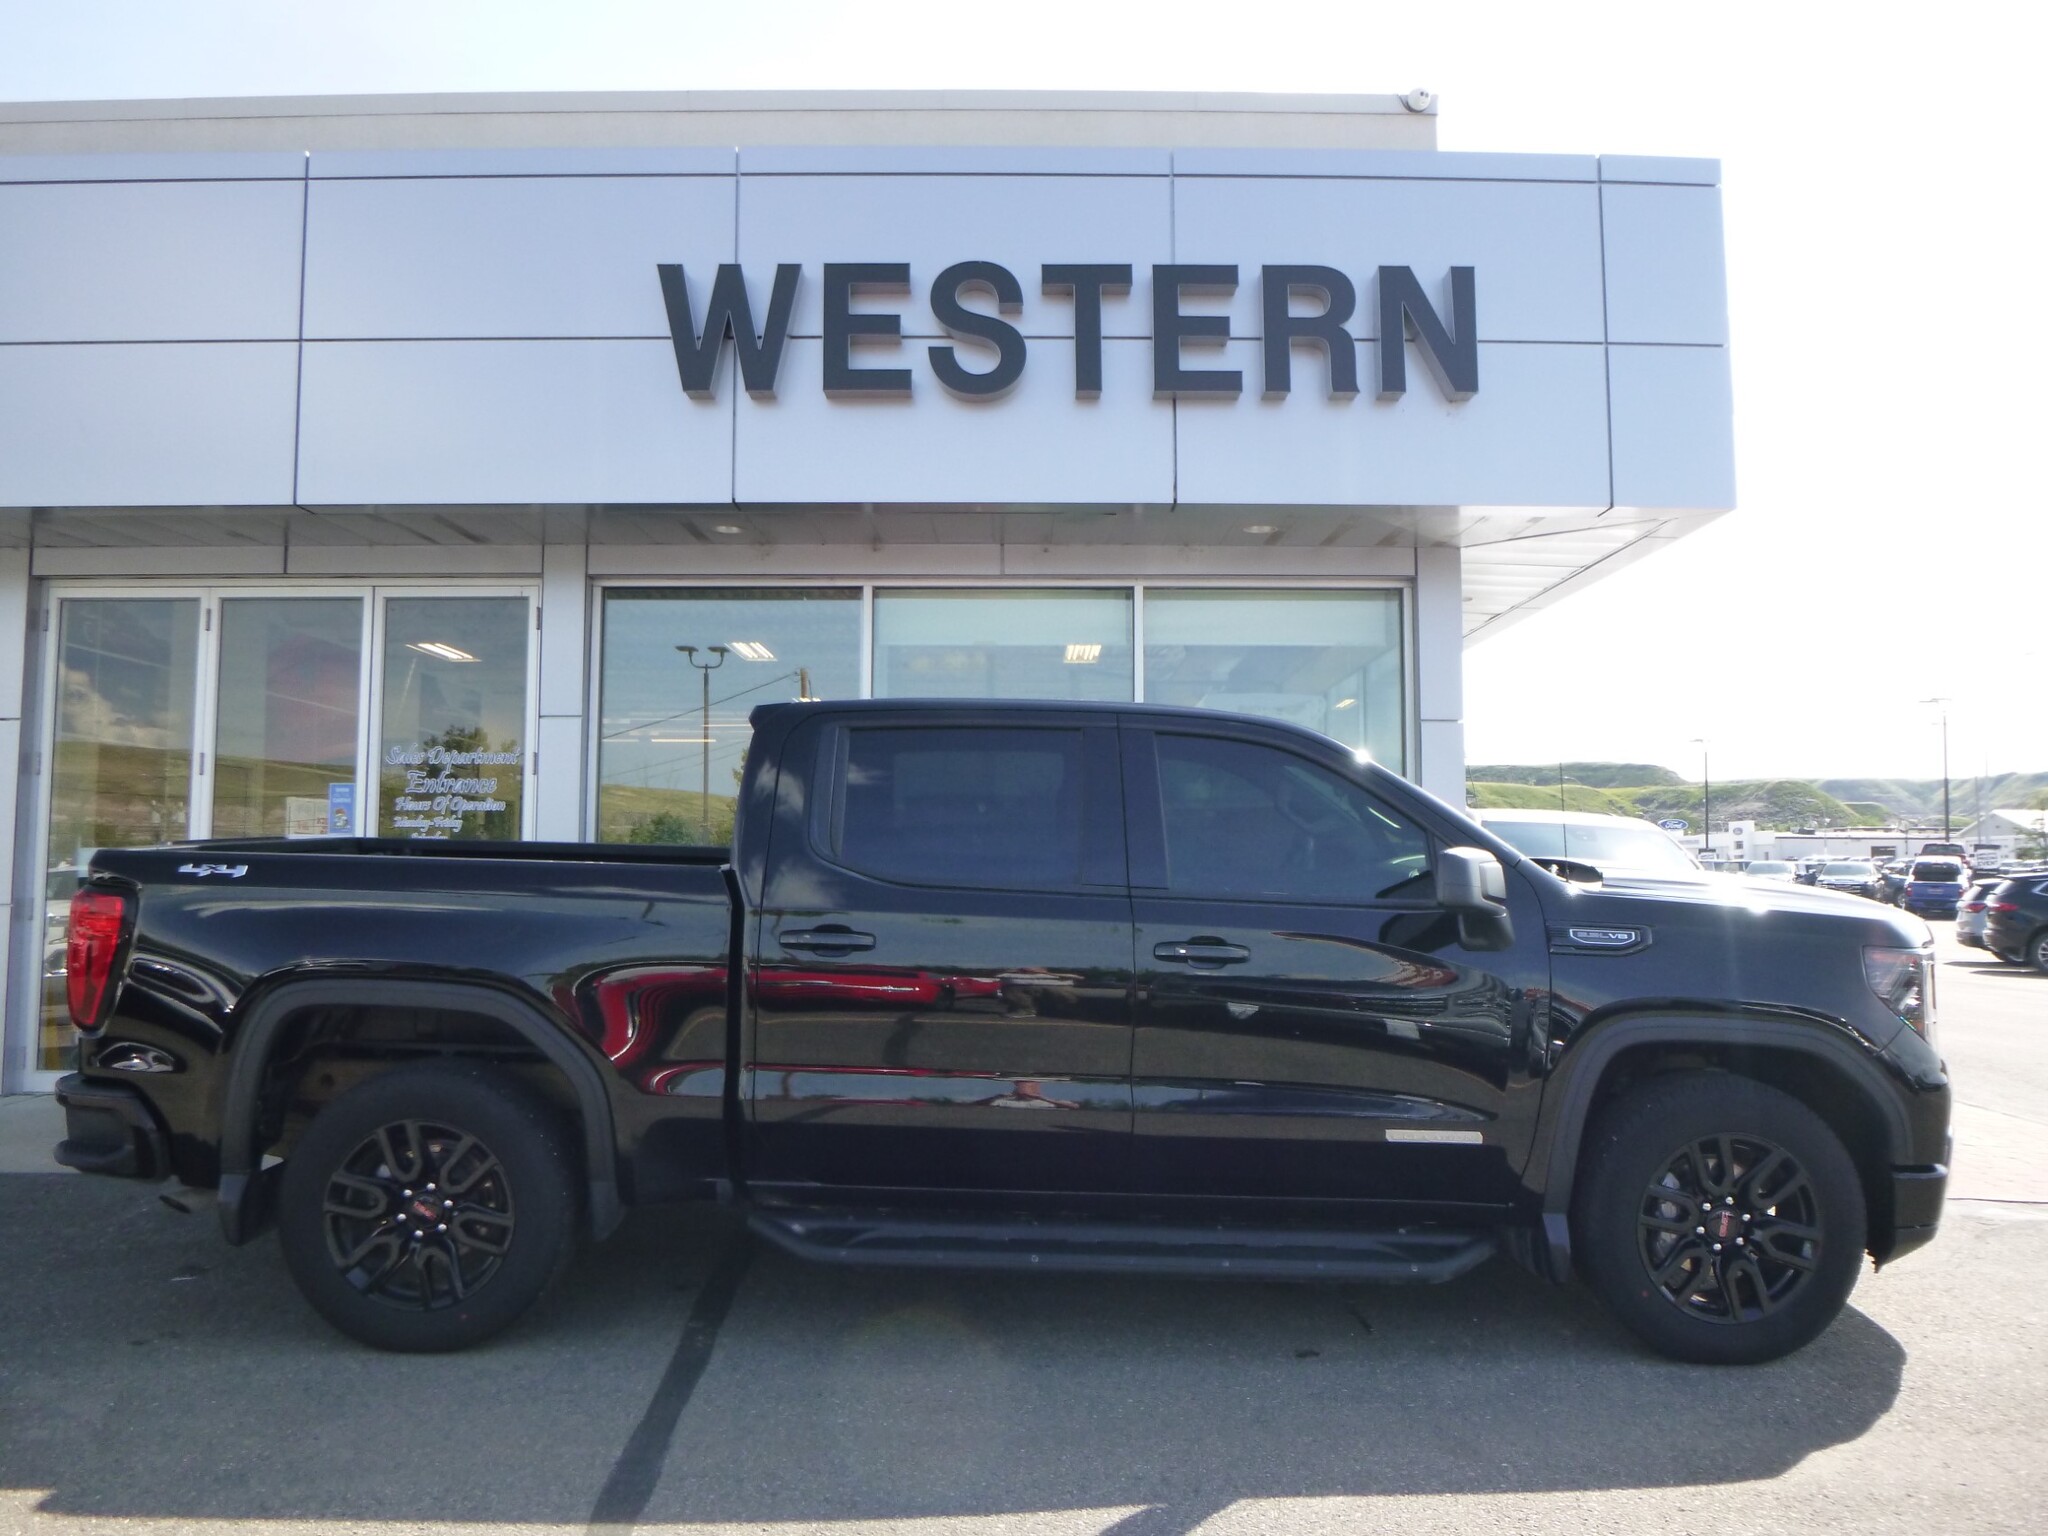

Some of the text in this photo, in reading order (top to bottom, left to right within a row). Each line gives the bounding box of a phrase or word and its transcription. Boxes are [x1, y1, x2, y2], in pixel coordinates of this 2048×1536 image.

[656, 260, 1479, 401] WESTERN
[385, 743, 522, 773] Sales Department
[405, 769, 498, 794] Entrance
[394, 794, 506, 818] Hours Of Operation
